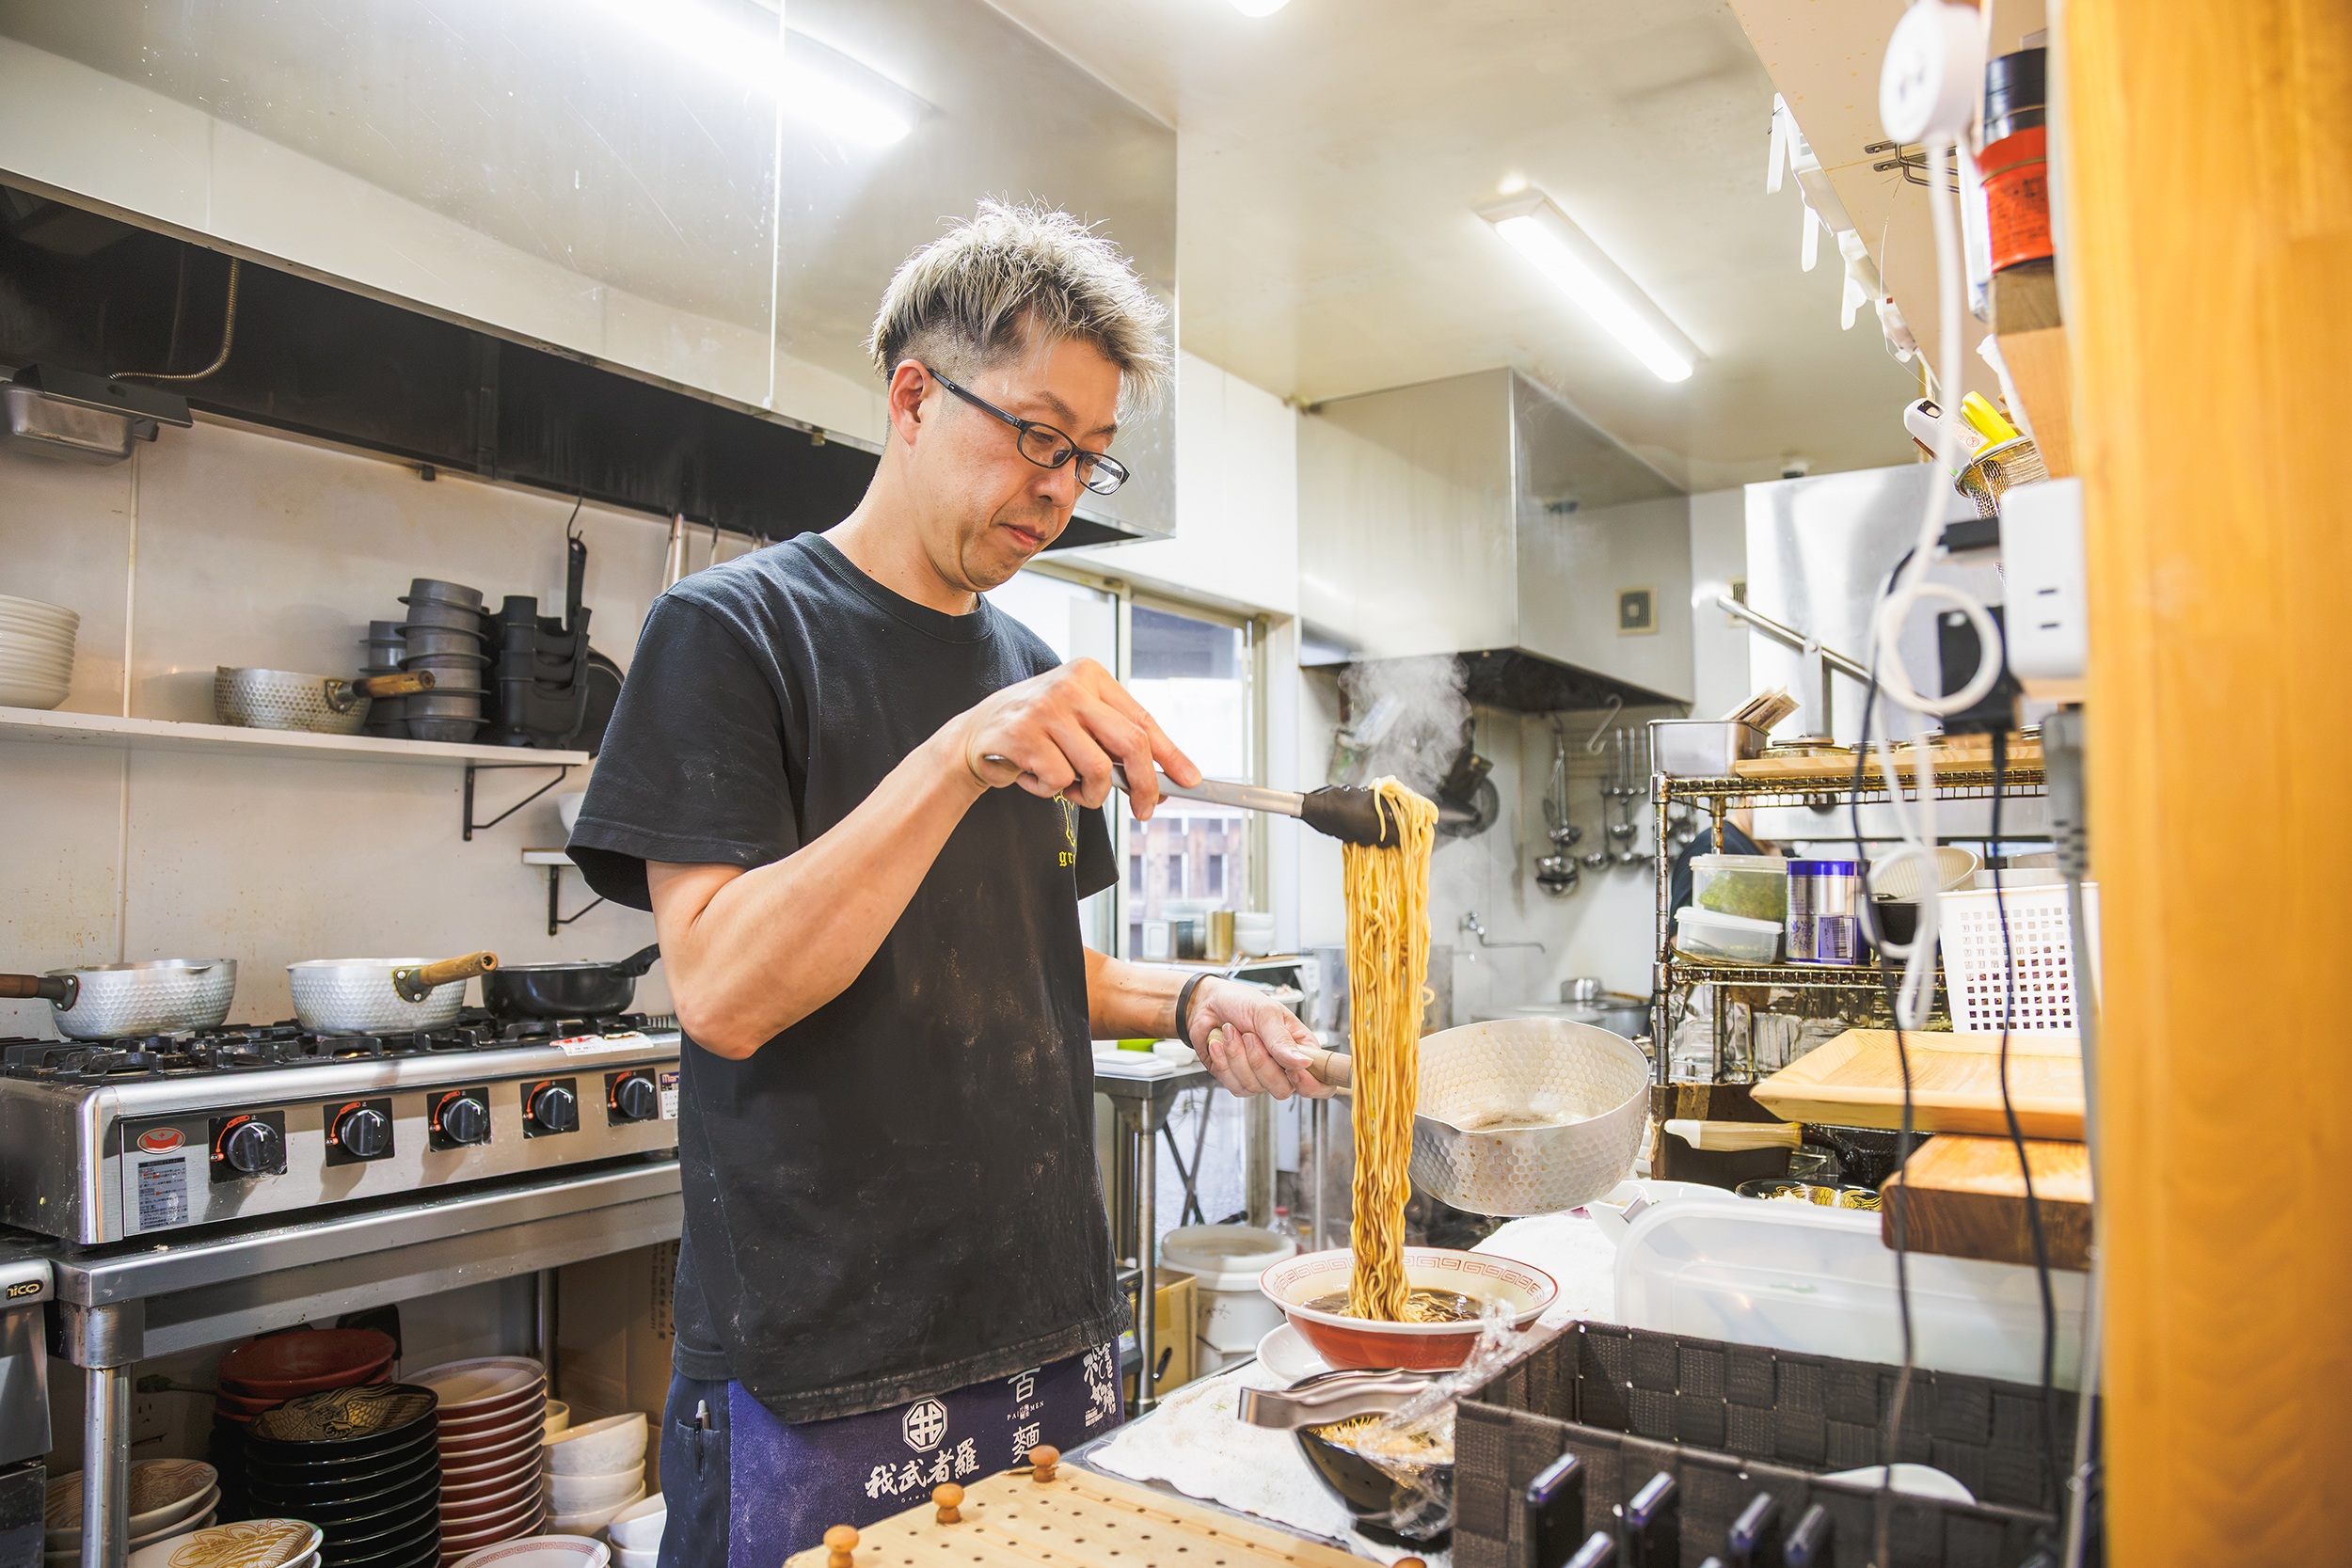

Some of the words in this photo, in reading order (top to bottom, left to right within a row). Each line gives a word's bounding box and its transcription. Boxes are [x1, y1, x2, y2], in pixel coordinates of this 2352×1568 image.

[1008, 1367, 1041, 1403] 百
[865, 1437, 980, 1499] 我武者羅
